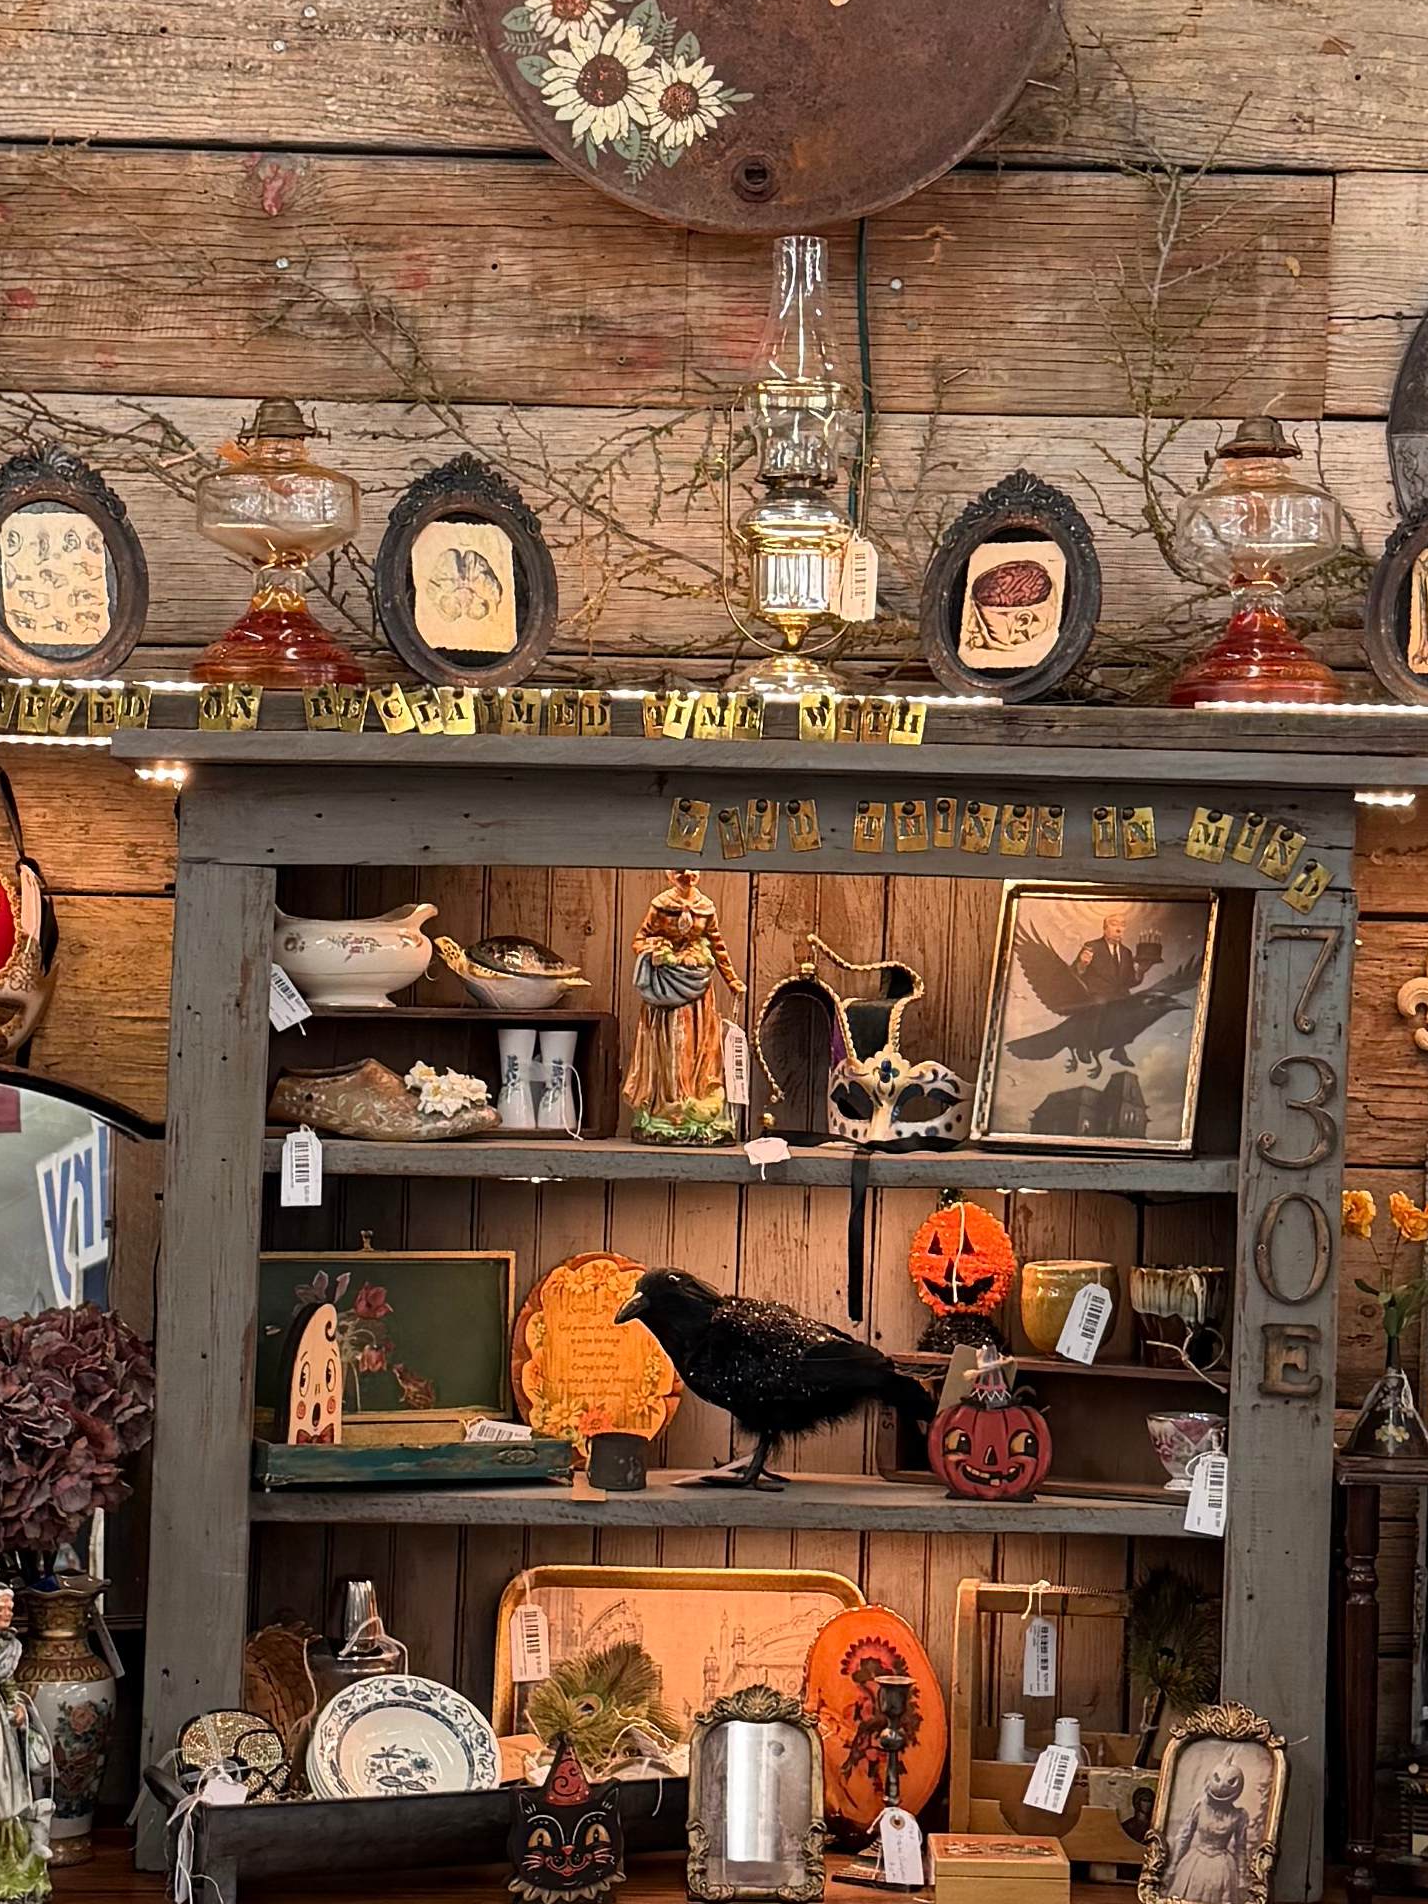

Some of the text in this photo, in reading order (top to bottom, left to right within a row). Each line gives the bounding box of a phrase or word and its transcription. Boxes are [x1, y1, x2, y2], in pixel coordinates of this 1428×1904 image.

[308, 696, 610, 728] RECLAIMED
[645, 699, 760, 729] TIME
[801, 704, 923, 736] WITH
[674, 810, 1322, 897] WILD THINGS IN MIND
